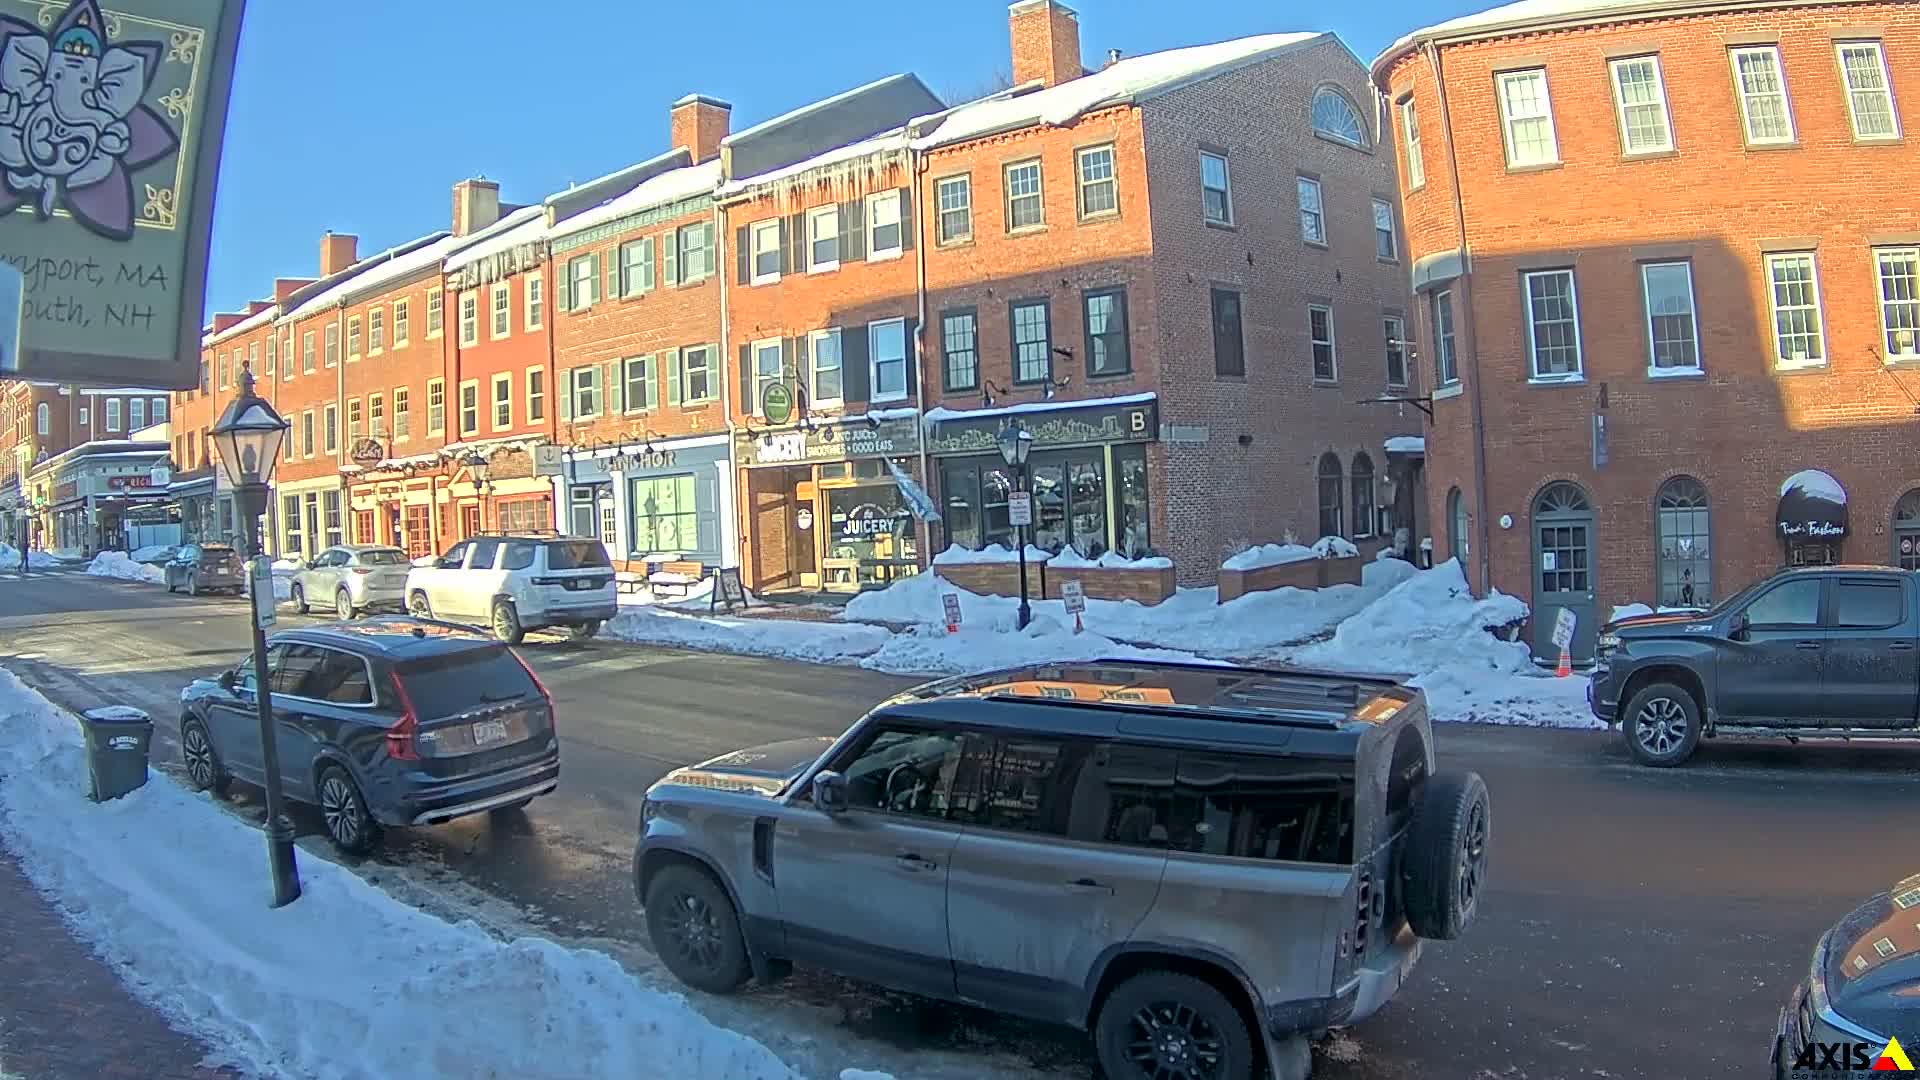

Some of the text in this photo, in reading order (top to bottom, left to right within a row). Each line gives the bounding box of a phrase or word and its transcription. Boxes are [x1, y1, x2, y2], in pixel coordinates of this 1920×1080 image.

[114, 261, 168, 291] MA
[105, 303, 157, 333] NH
[852, 441, 875, 453] GOOD
[843, 518, 895, 534] JUICERY
